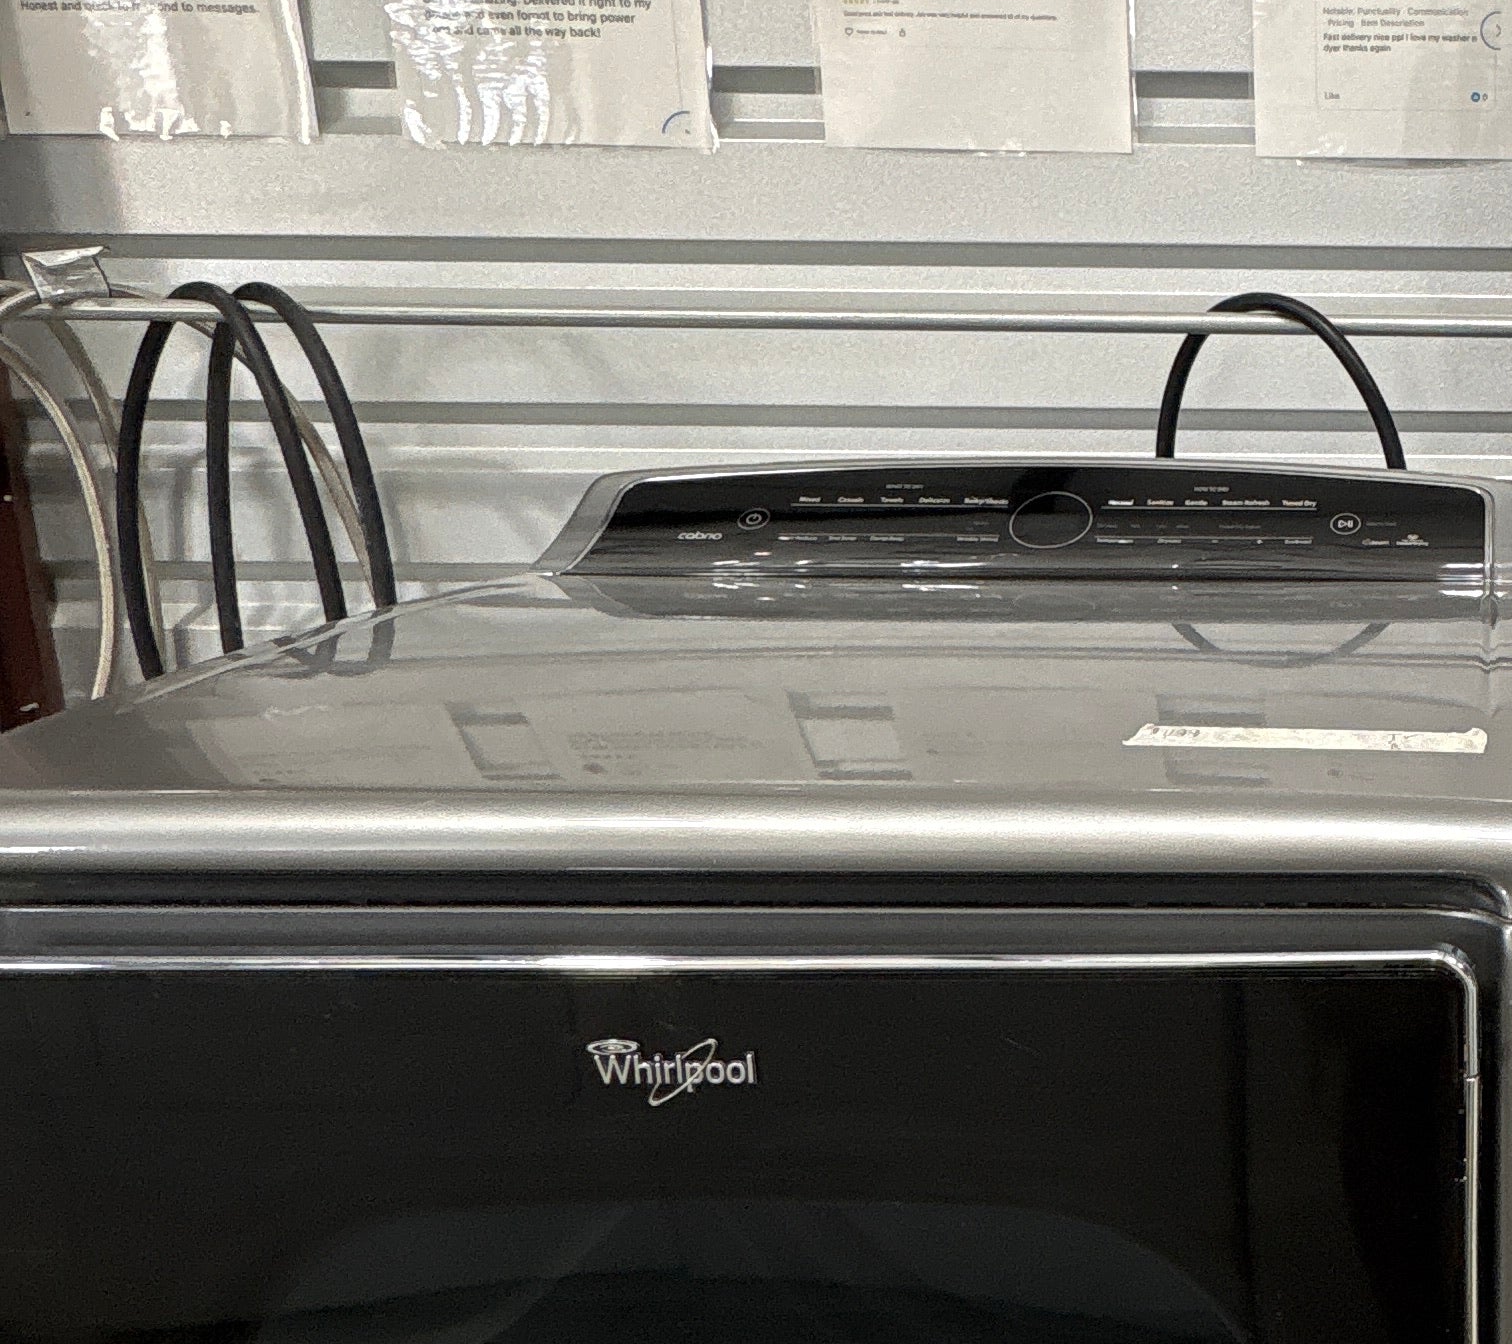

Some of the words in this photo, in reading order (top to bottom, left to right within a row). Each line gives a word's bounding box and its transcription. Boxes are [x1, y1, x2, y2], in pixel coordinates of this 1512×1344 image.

[20, 0, 58, 10] Honest
[60, 0, 85, 10] and
[633, 0, 651, 10] my
[552, 10, 564, 21] to
[567, 10, 597, 24] bring
[599, 13, 634, 25] power
[508, 24, 521, 35] all
[524, 24, 542, 36] the
[544, 27, 566, 39] way
[590, 1045, 758, 1099] Whirlpool
